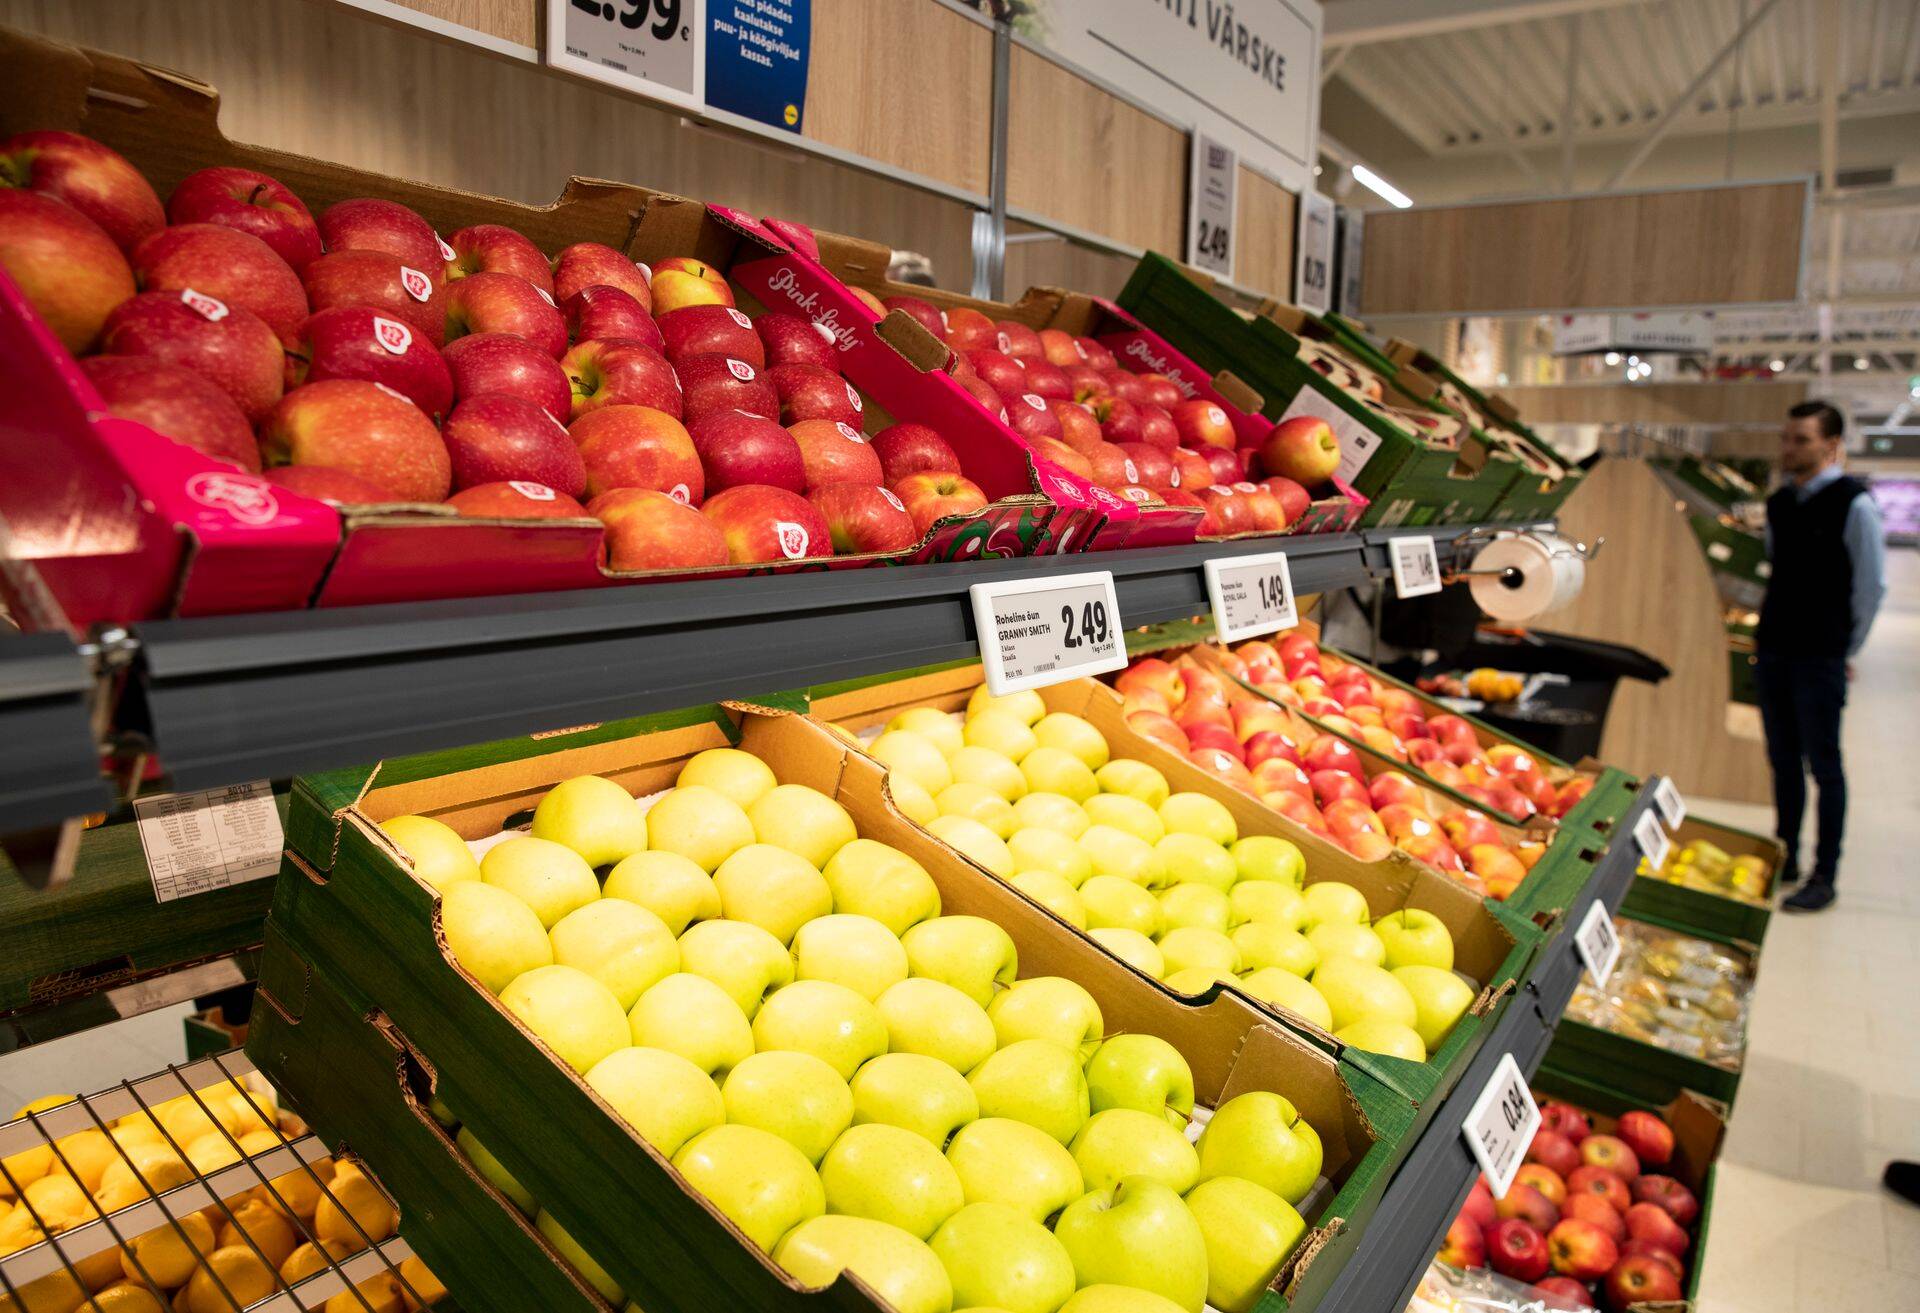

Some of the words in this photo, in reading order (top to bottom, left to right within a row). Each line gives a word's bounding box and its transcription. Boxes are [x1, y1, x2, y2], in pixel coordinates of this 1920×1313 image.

[734, 6, 784, 37] kaalutakse
[757, 1, 793, 24] pidades
[681, 26, 689, 41] €
[714, 18, 738, 35] puu-
[738, 25, 748, 41] ja
[749, 30, 800, 61] köögiviljad
[1207, 0, 1286, 93] VÄRSKE
[740, 44, 773, 68] kassas.
[768, 267, 819, 313] Pink
[811, 306, 859, 352] Lady
[1126, 339, 1167, 374] Pink
[1258, 575, 1284, 610] 1.49
[995, 612, 1026, 625] Roheline
[1027, 611, 1040, 623] õun
[998, 626, 1029, 641] GRANNY
[1029, 623, 1051, 636] SMITH
[1061, 601, 1107, 648] 2.49
[1004, 644, 1016, 652] klass
[1502, 1081, 1526, 1131] 0.84
